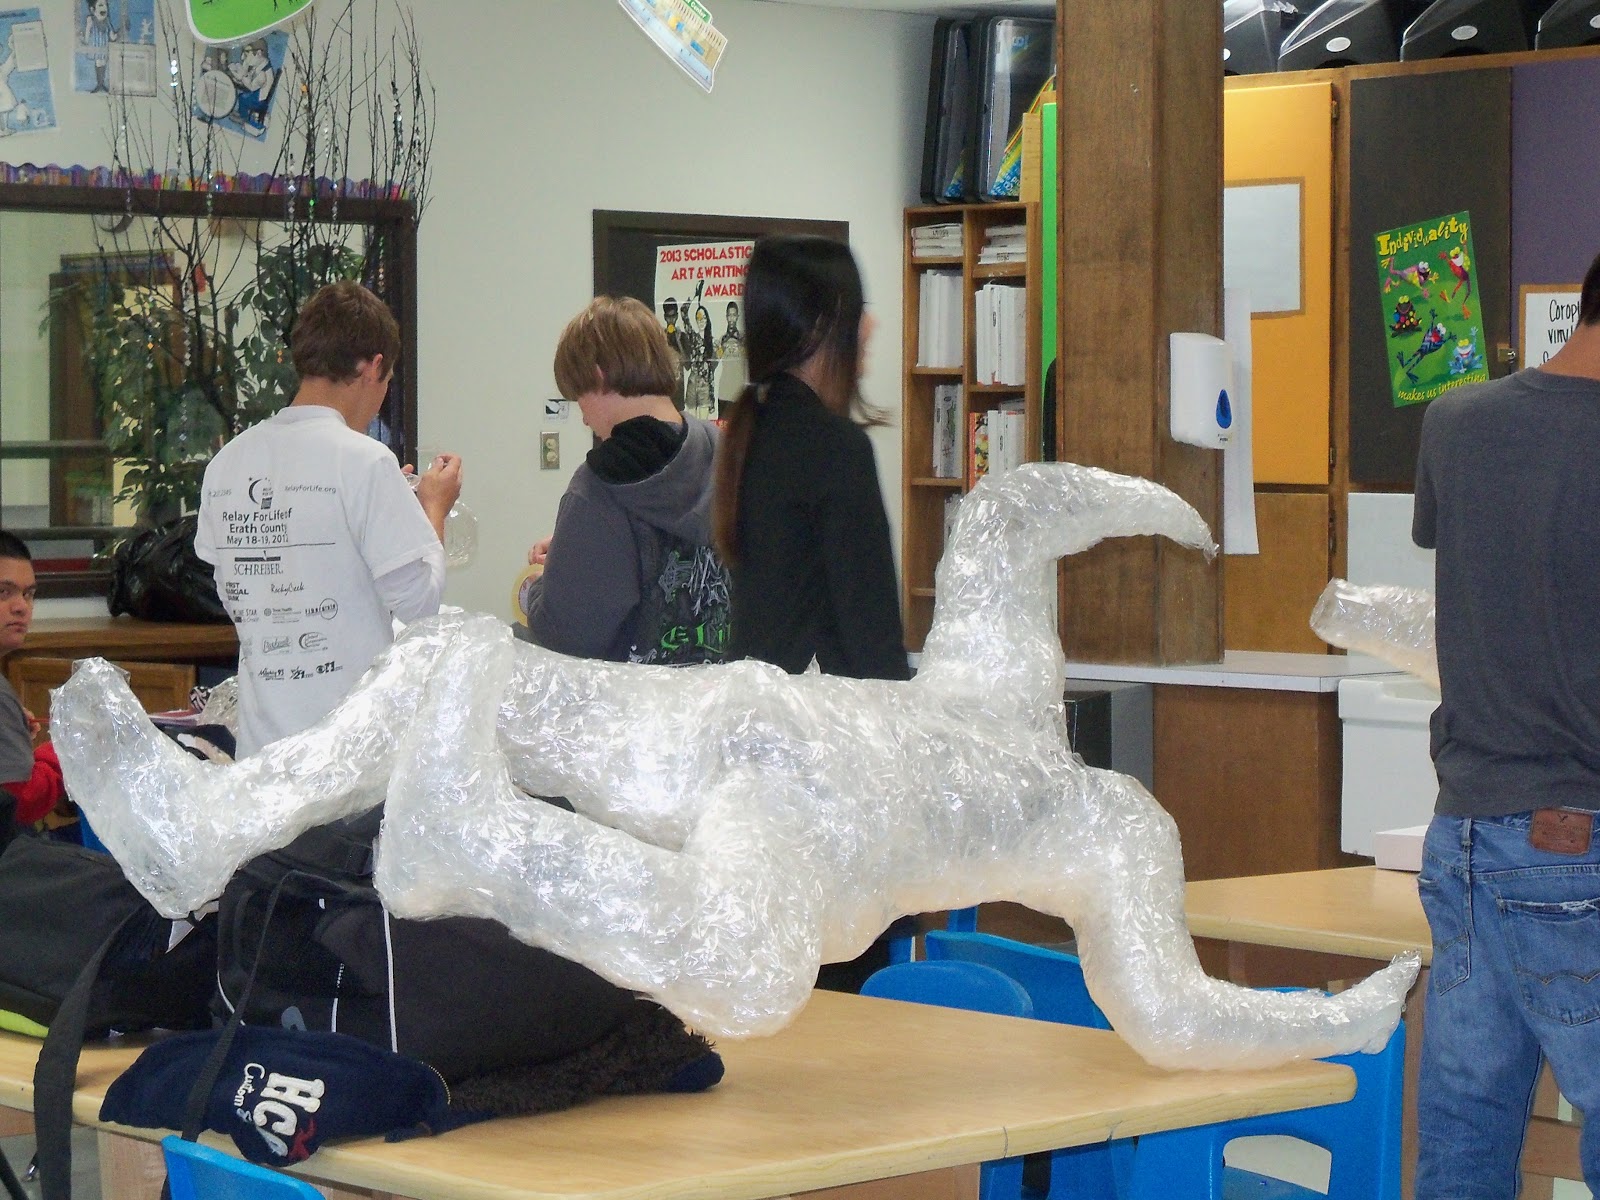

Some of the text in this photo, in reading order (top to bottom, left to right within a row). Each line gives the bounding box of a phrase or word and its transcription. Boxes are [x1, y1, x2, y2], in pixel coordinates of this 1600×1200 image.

[1377, 217, 1468, 256] Individuality
[660, 245, 752, 263] 2013 SCHOLASTIC
[671, 267, 694, 281] ART
[696, 267, 703, 279] &
[705, 283, 748, 297] AWARD
[1397, 387, 1425, 401] makes
[1427, 387, 1437, 399] us
[222, 511, 250, 523] Relay
[253, 512, 268, 521] For
[229, 523, 257, 534] Erath
[226, 535, 242, 547] May
[233, 1062, 266, 1107] Custom
